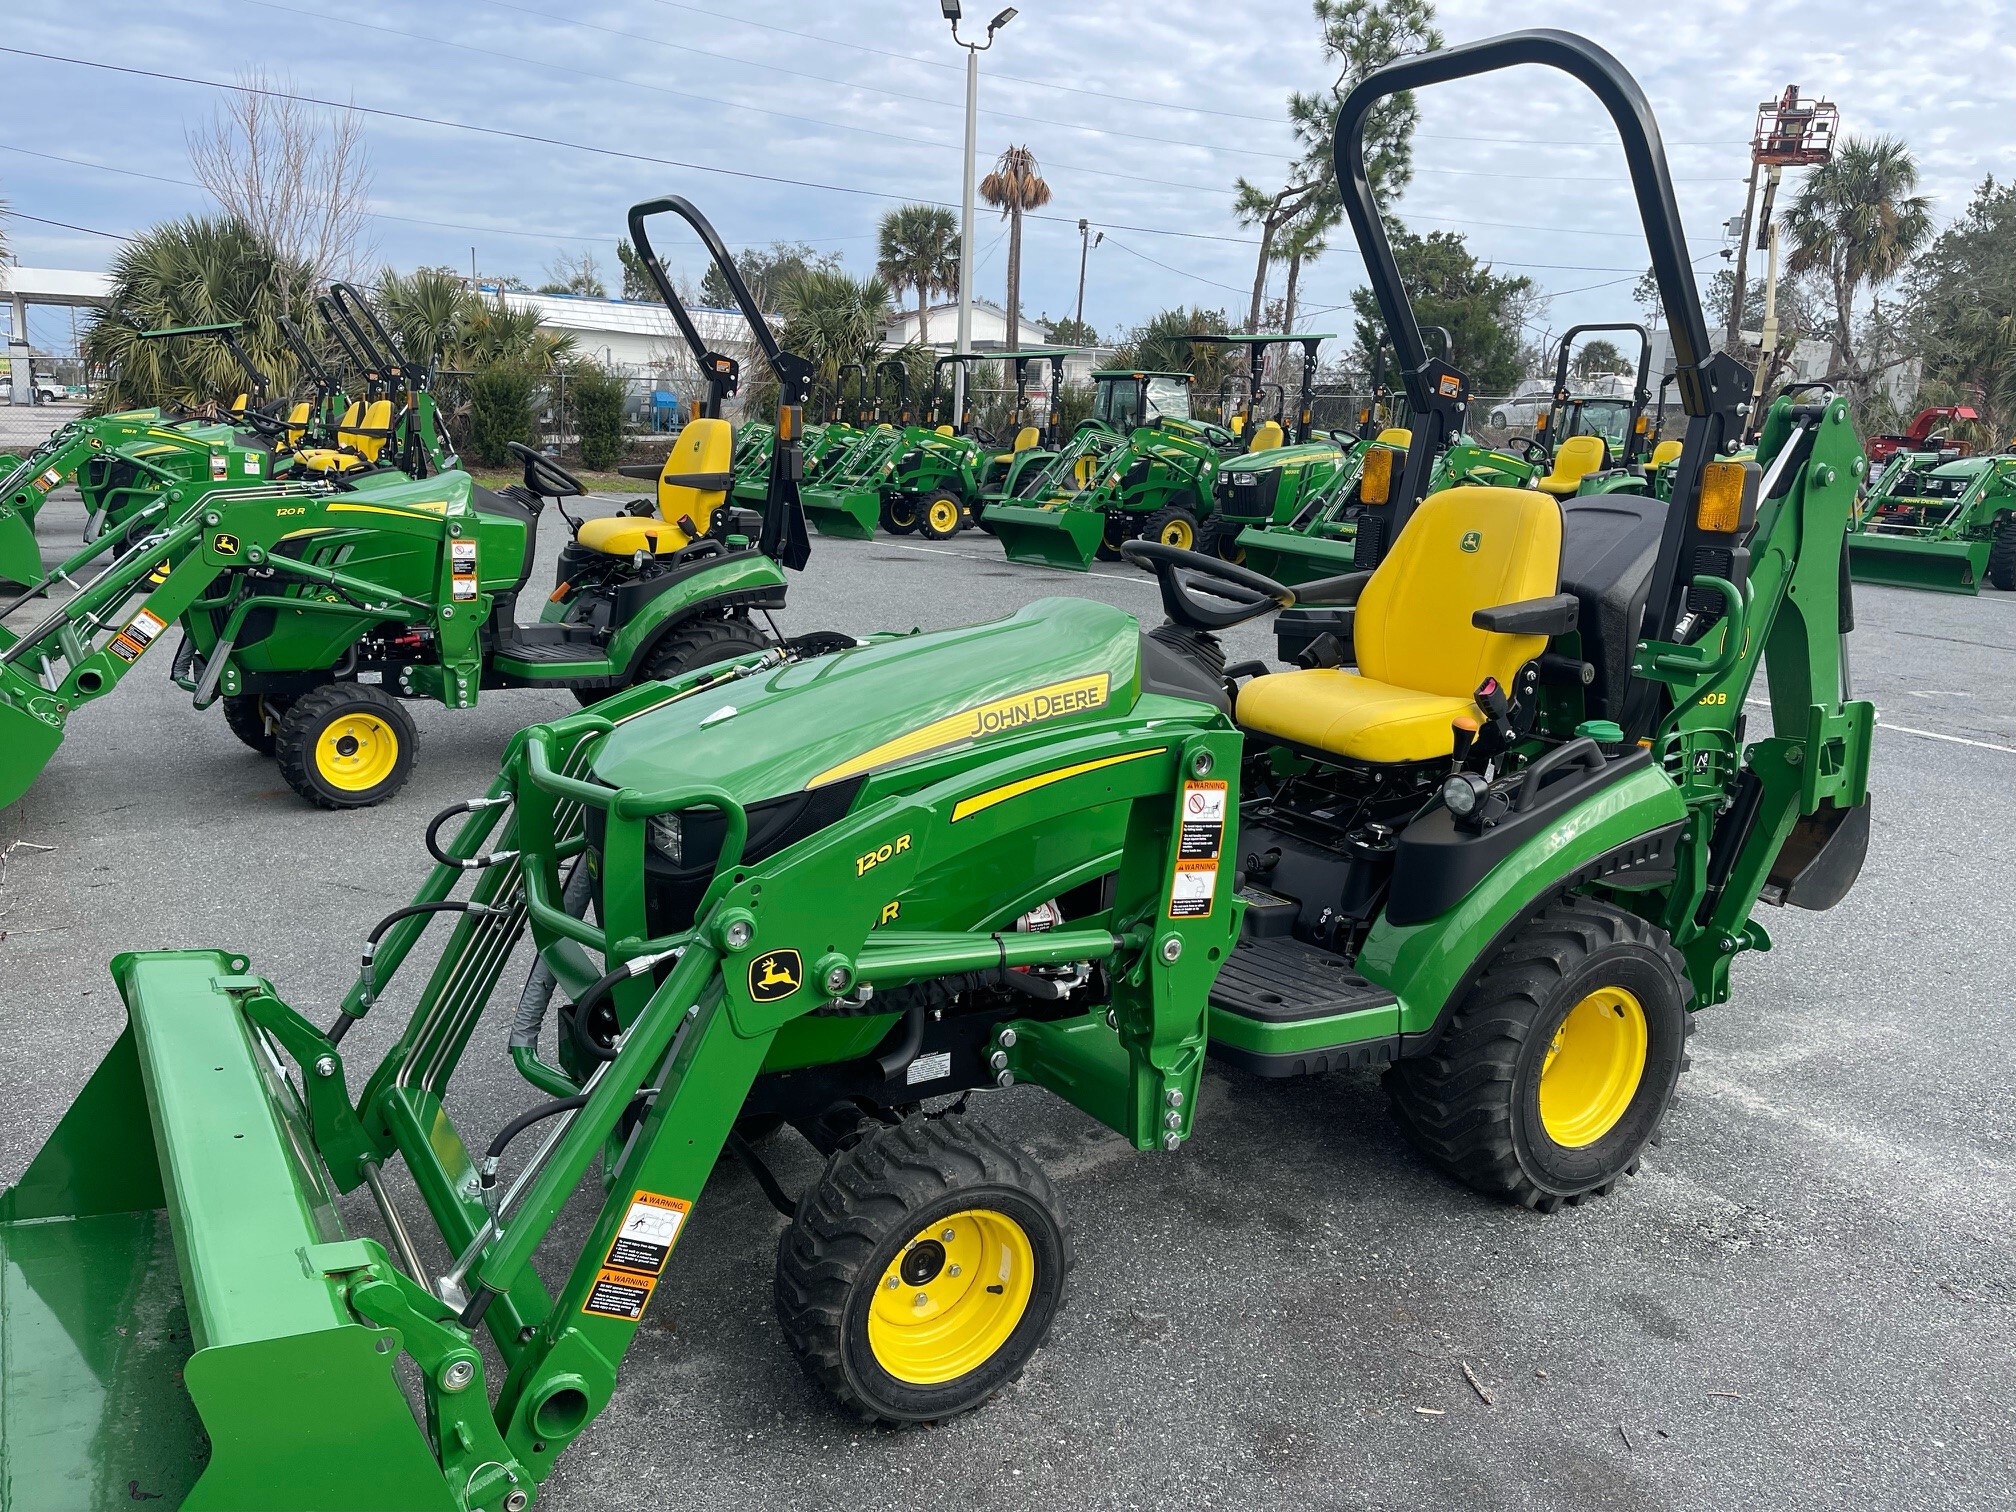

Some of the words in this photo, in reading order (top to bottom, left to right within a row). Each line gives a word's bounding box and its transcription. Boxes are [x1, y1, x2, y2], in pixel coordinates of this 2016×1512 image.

[276, 508, 296, 517] 120
[296, 507, 306, 515] R
[971, 703, 1031, 735] JOHN
[1033, 686, 1101, 718] DEERE
[1193, 782, 1225, 790] WARNING
[856, 843, 894, 878] 120
[895, 833, 912, 856] R
[1184, 863, 1216, 871] WARNING
[881, 900, 901, 926] R
[649, 1196, 683, 1209] WARNING
[614, 1275, 649, 1287] WARNING
